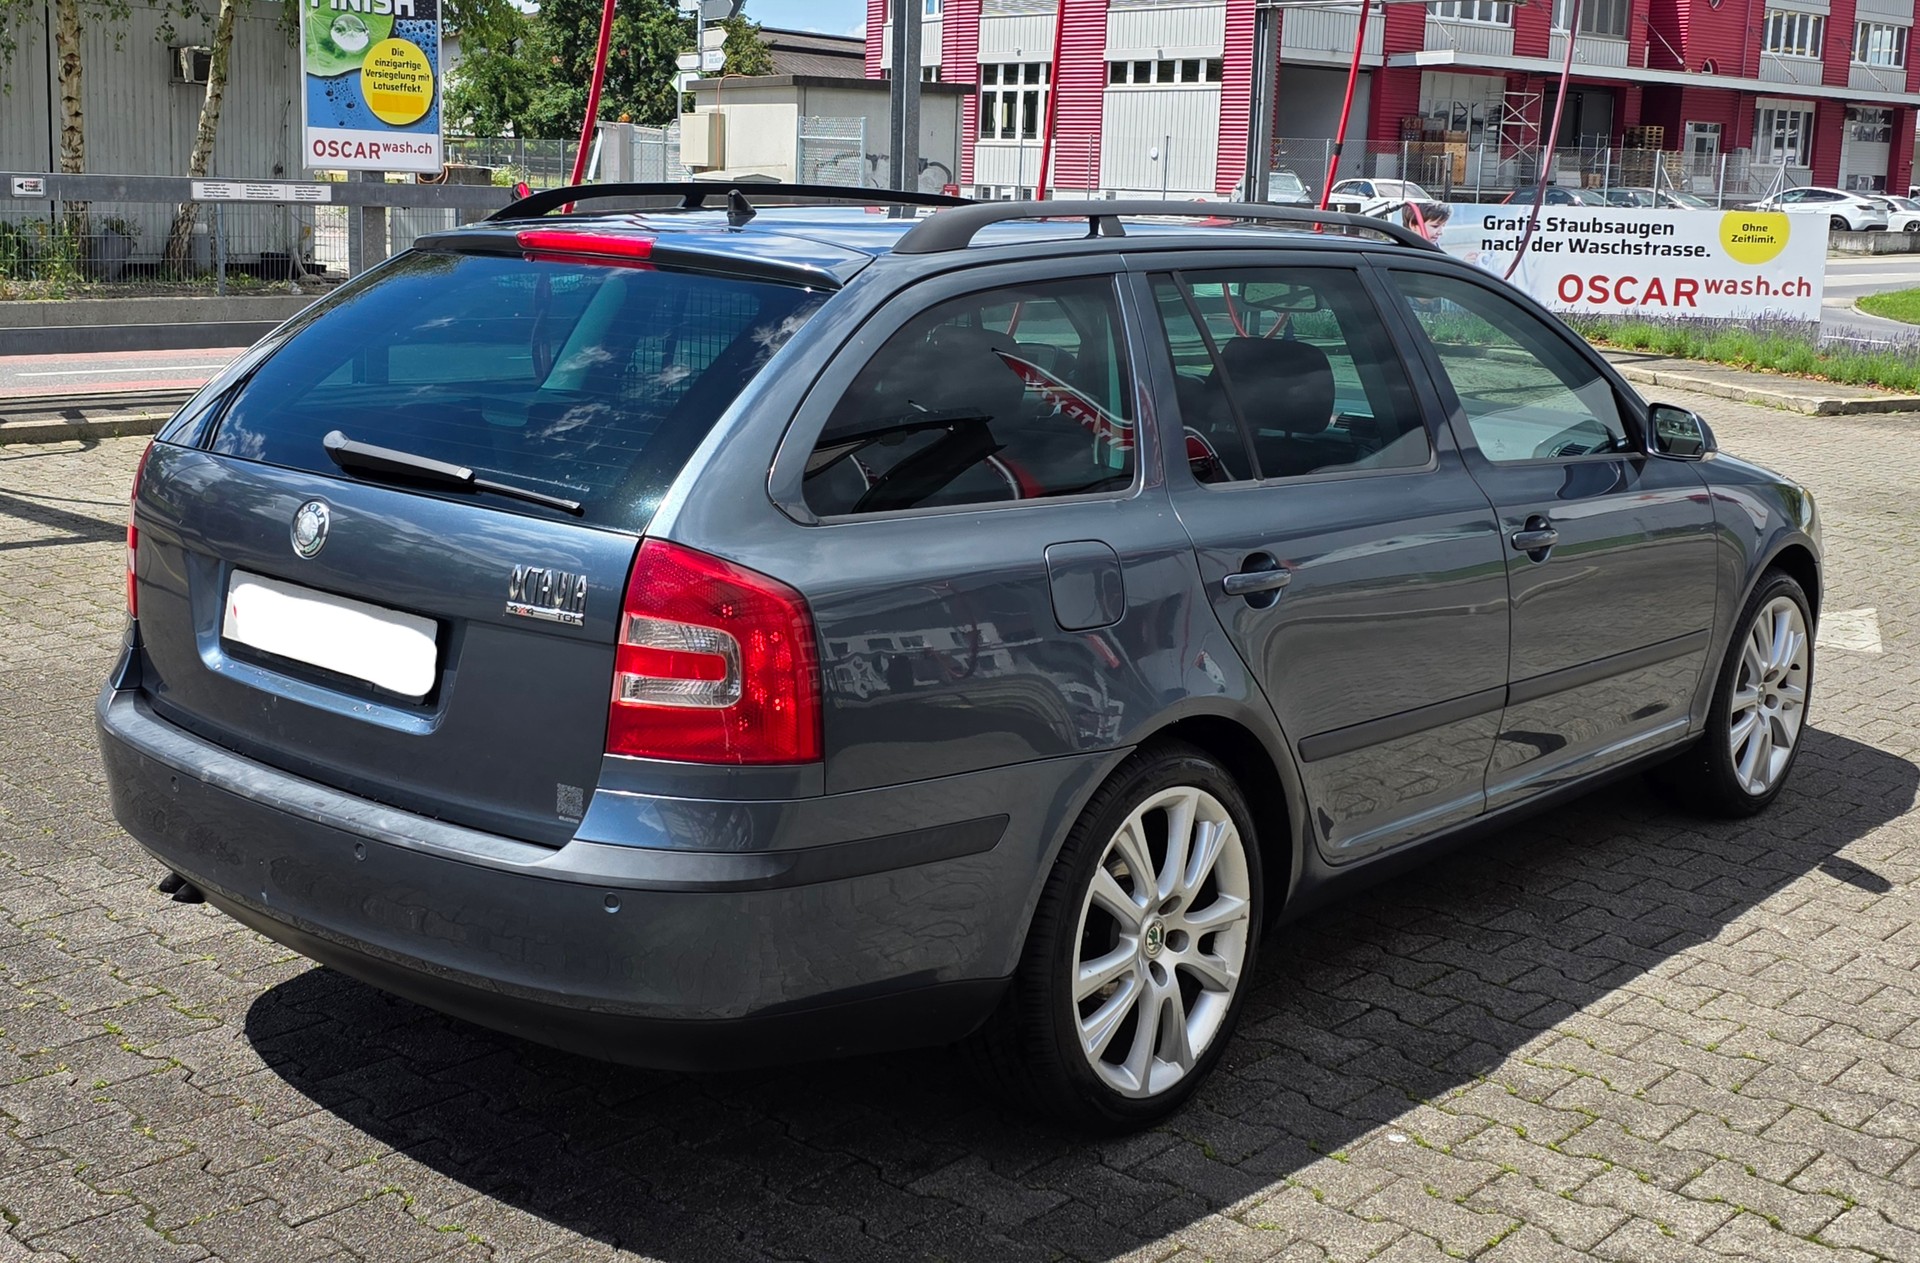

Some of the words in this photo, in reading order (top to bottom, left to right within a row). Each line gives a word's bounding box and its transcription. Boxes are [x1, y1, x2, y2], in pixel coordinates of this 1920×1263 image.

[310, 0, 415, 17] ISH
[391, 48, 405, 57] Die
[374, 58, 422, 70] einzigartige
[365, 69, 416, 82] Versiegelung
[373, 81, 423, 93] Lotuseffekt.
[313, 139, 381, 160] OSCAR
[382, 141, 432, 155] wash.ch
[1483, 215, 1541, 232] Gratis
[1546, 217, 1675, 239] Staubsaugen
[1741, 223, 1769, 233] Ohne
[1731, 234, 1777, 244] Zeitlimit.
[1531, 237, 1564, 253] der
[1567, 238, 1712, 258] Waschstrasse.
[1557, 274, 1700, 308] OSCAR
[1704, 275, 1812, 298] wash.ch
